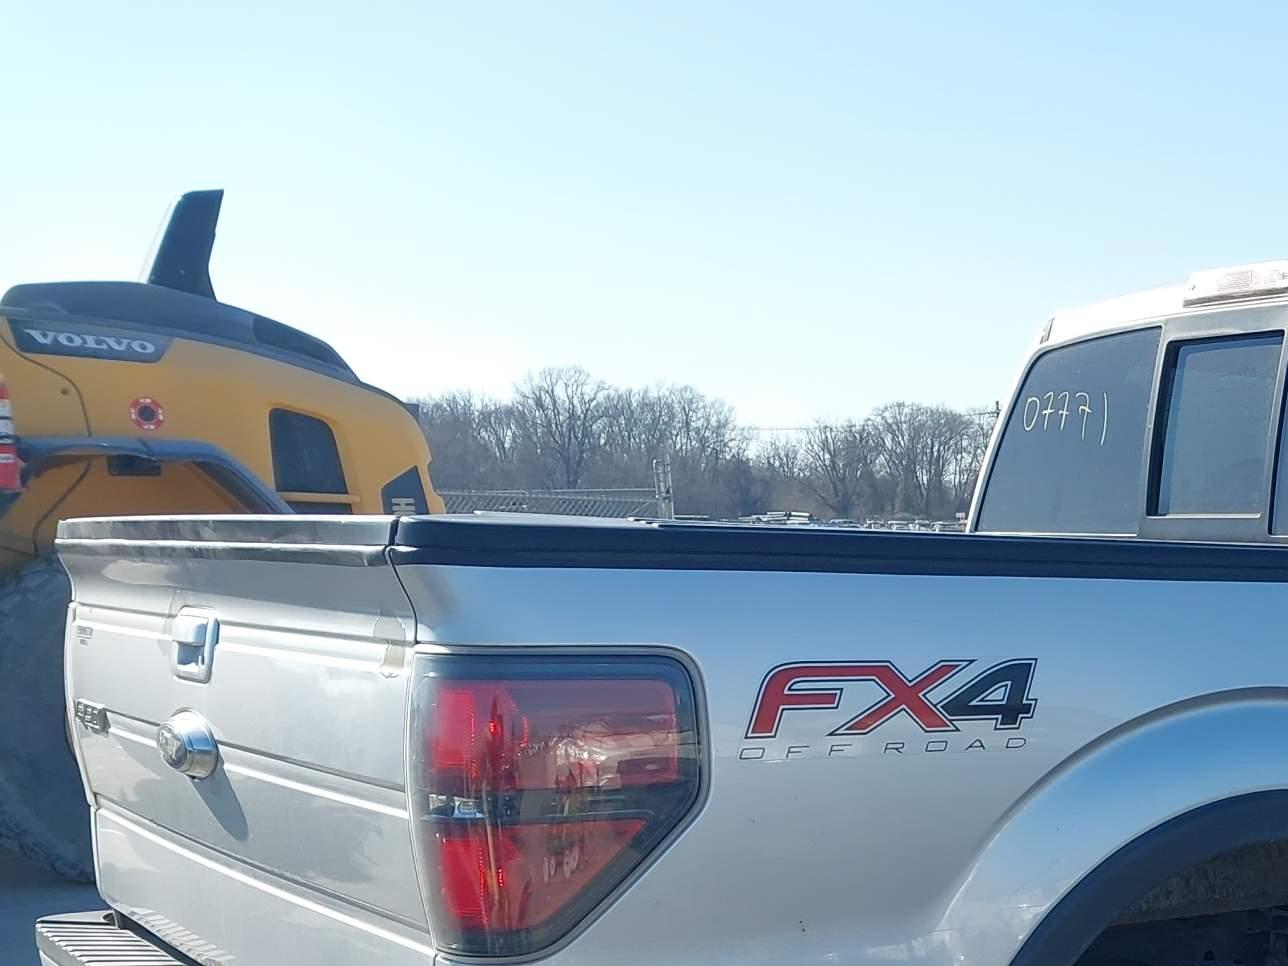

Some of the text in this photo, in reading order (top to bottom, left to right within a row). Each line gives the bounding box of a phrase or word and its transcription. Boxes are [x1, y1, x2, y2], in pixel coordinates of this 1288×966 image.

[24, 329, 156, 354] VOLVO
[1023, 391, 1108, 446] 07771
[744, 657, 1039, 740] FX4
[739, 737, 1028, 760] OFF ROAD
